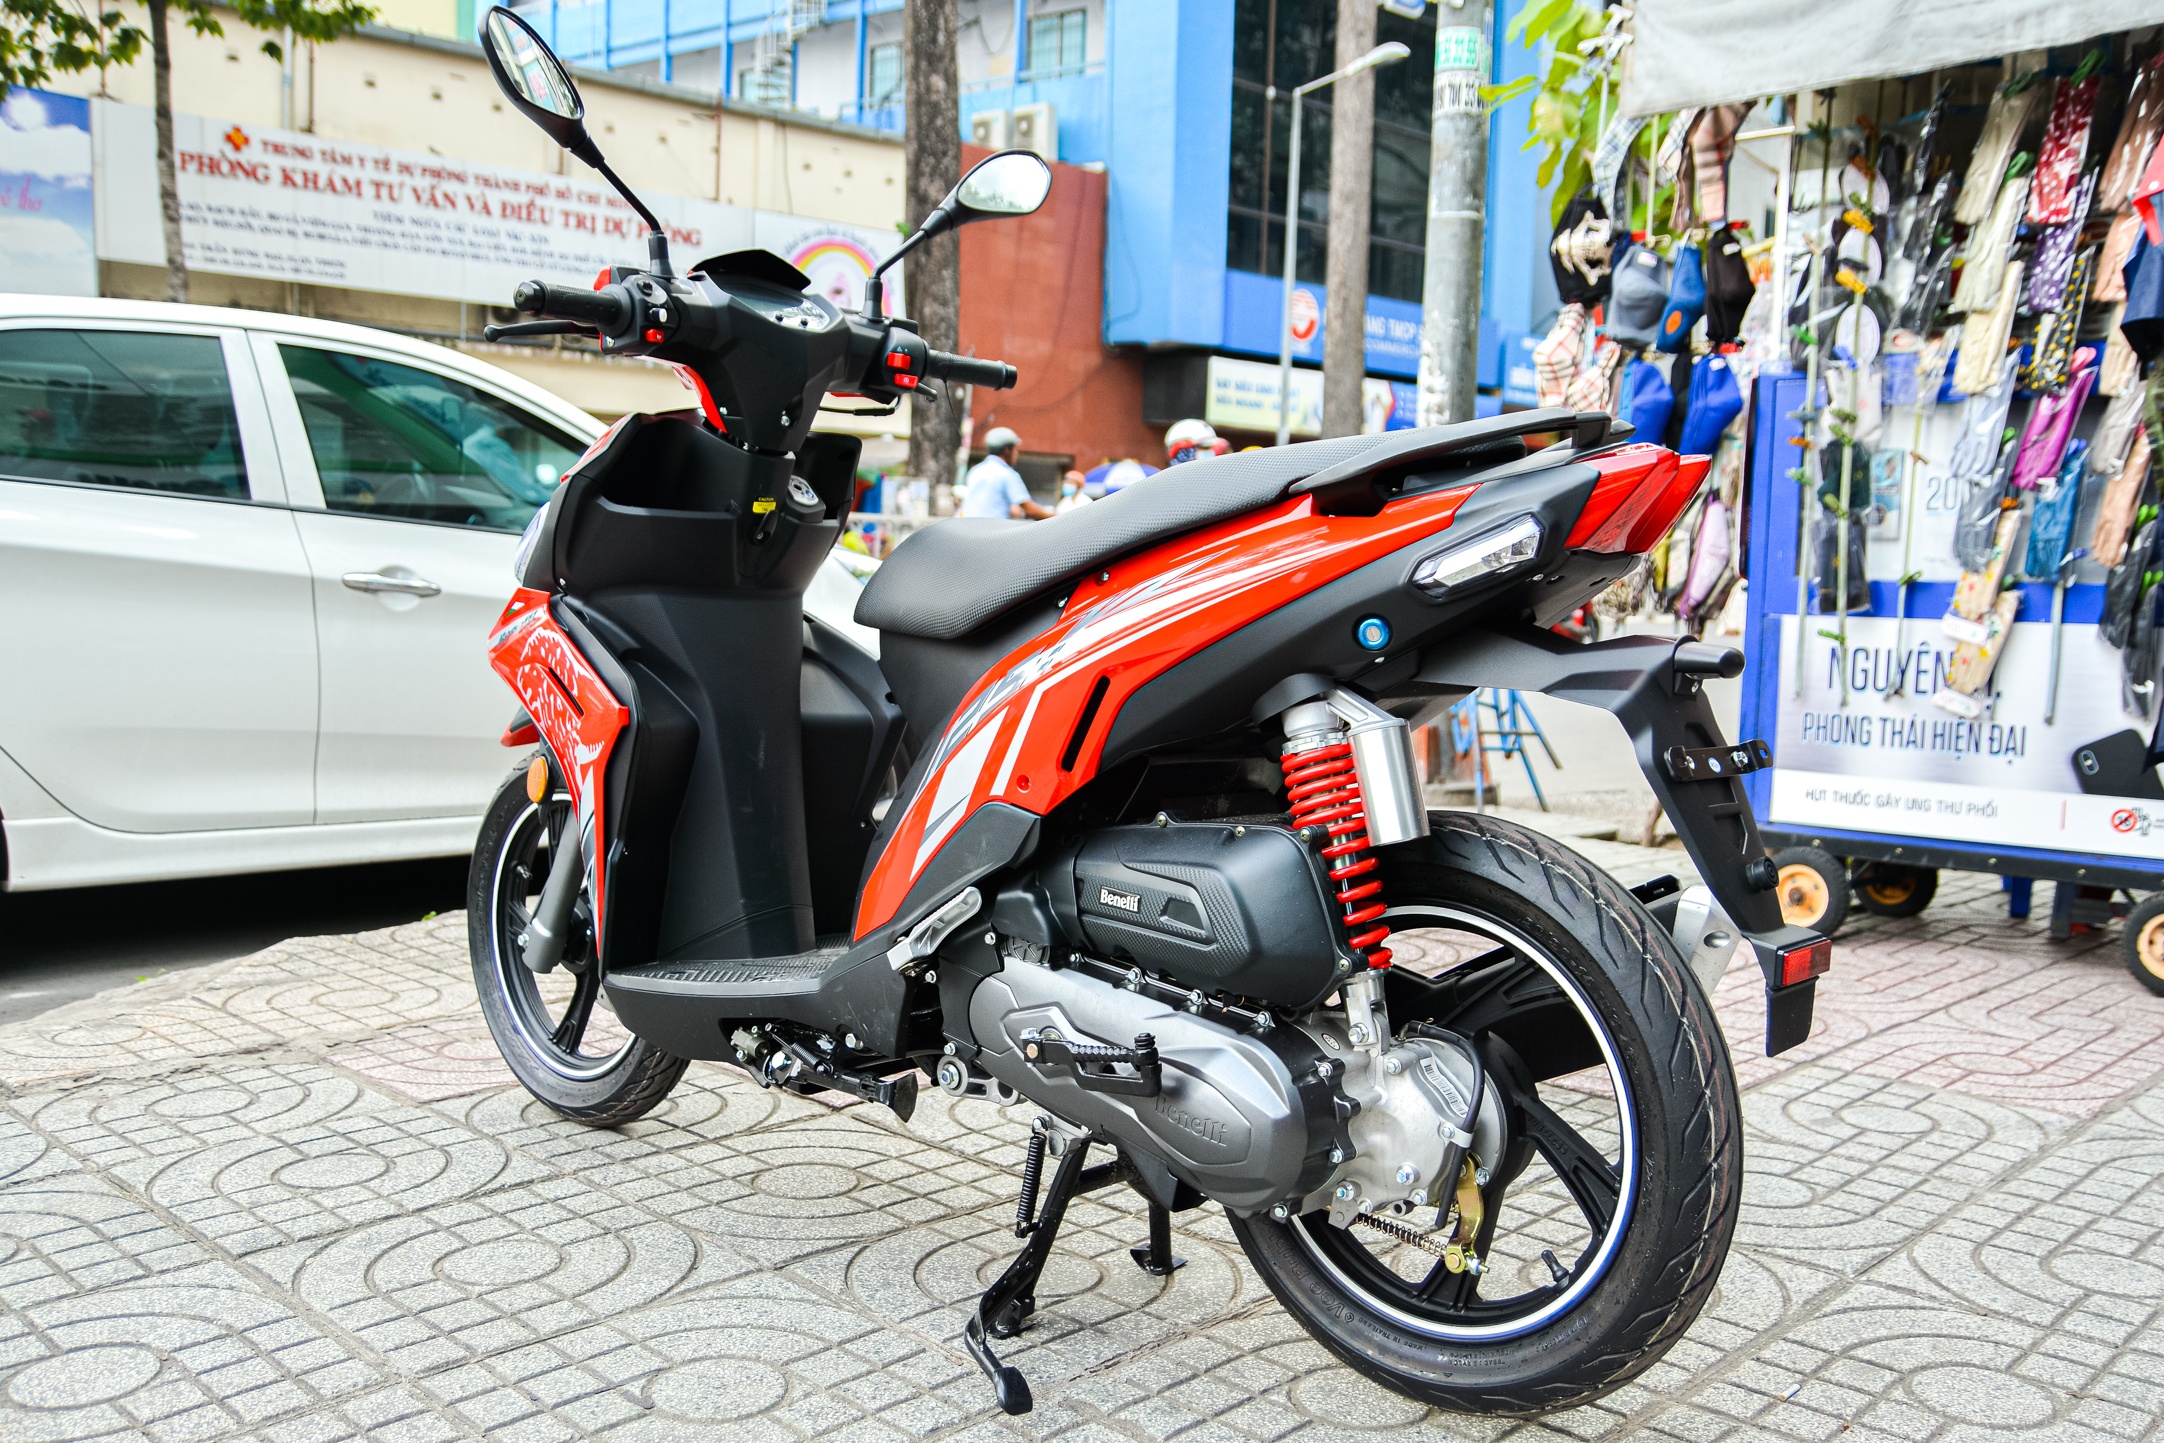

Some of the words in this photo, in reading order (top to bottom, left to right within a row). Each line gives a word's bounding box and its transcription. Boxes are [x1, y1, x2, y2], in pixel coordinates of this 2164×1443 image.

[262, 140, 314, 159] TRUNG
[320, 147, 353, 165] TÂM
[179, 148, 271, 184] PHÒNG
[281, 169, 363, 198] KHÁM
[369, 178, 405, 202] TƯ
[412, 181, 459, 209] VẤN
[465, 189, 492, 217] VÀ
[501, 199, 554, 225] ĐIỀU
[560, 208, 597, 235] TRỊ
[604, 216, 633, 240] DỰ
[1801, 712, 1873, 747] PHONG
[1879, 713, 1926, 750] THÁI
[1932, 715, 1983, 760] HIỆN
[1988, 723, 2027, 764] ĐẠI
[1805, 787, 1827, 802] HÚT
[1832, 788, 1872, 807] THUỐC
[1875, 793, 1902, 809] GÂY
[1937, 799, 1965, 815] THƯ
[1968, 799, 1999, 818] PHỔI
[1100, 888, 1138, 912] Benelli
[1154, 1094, 1228, 1147] Benelli
